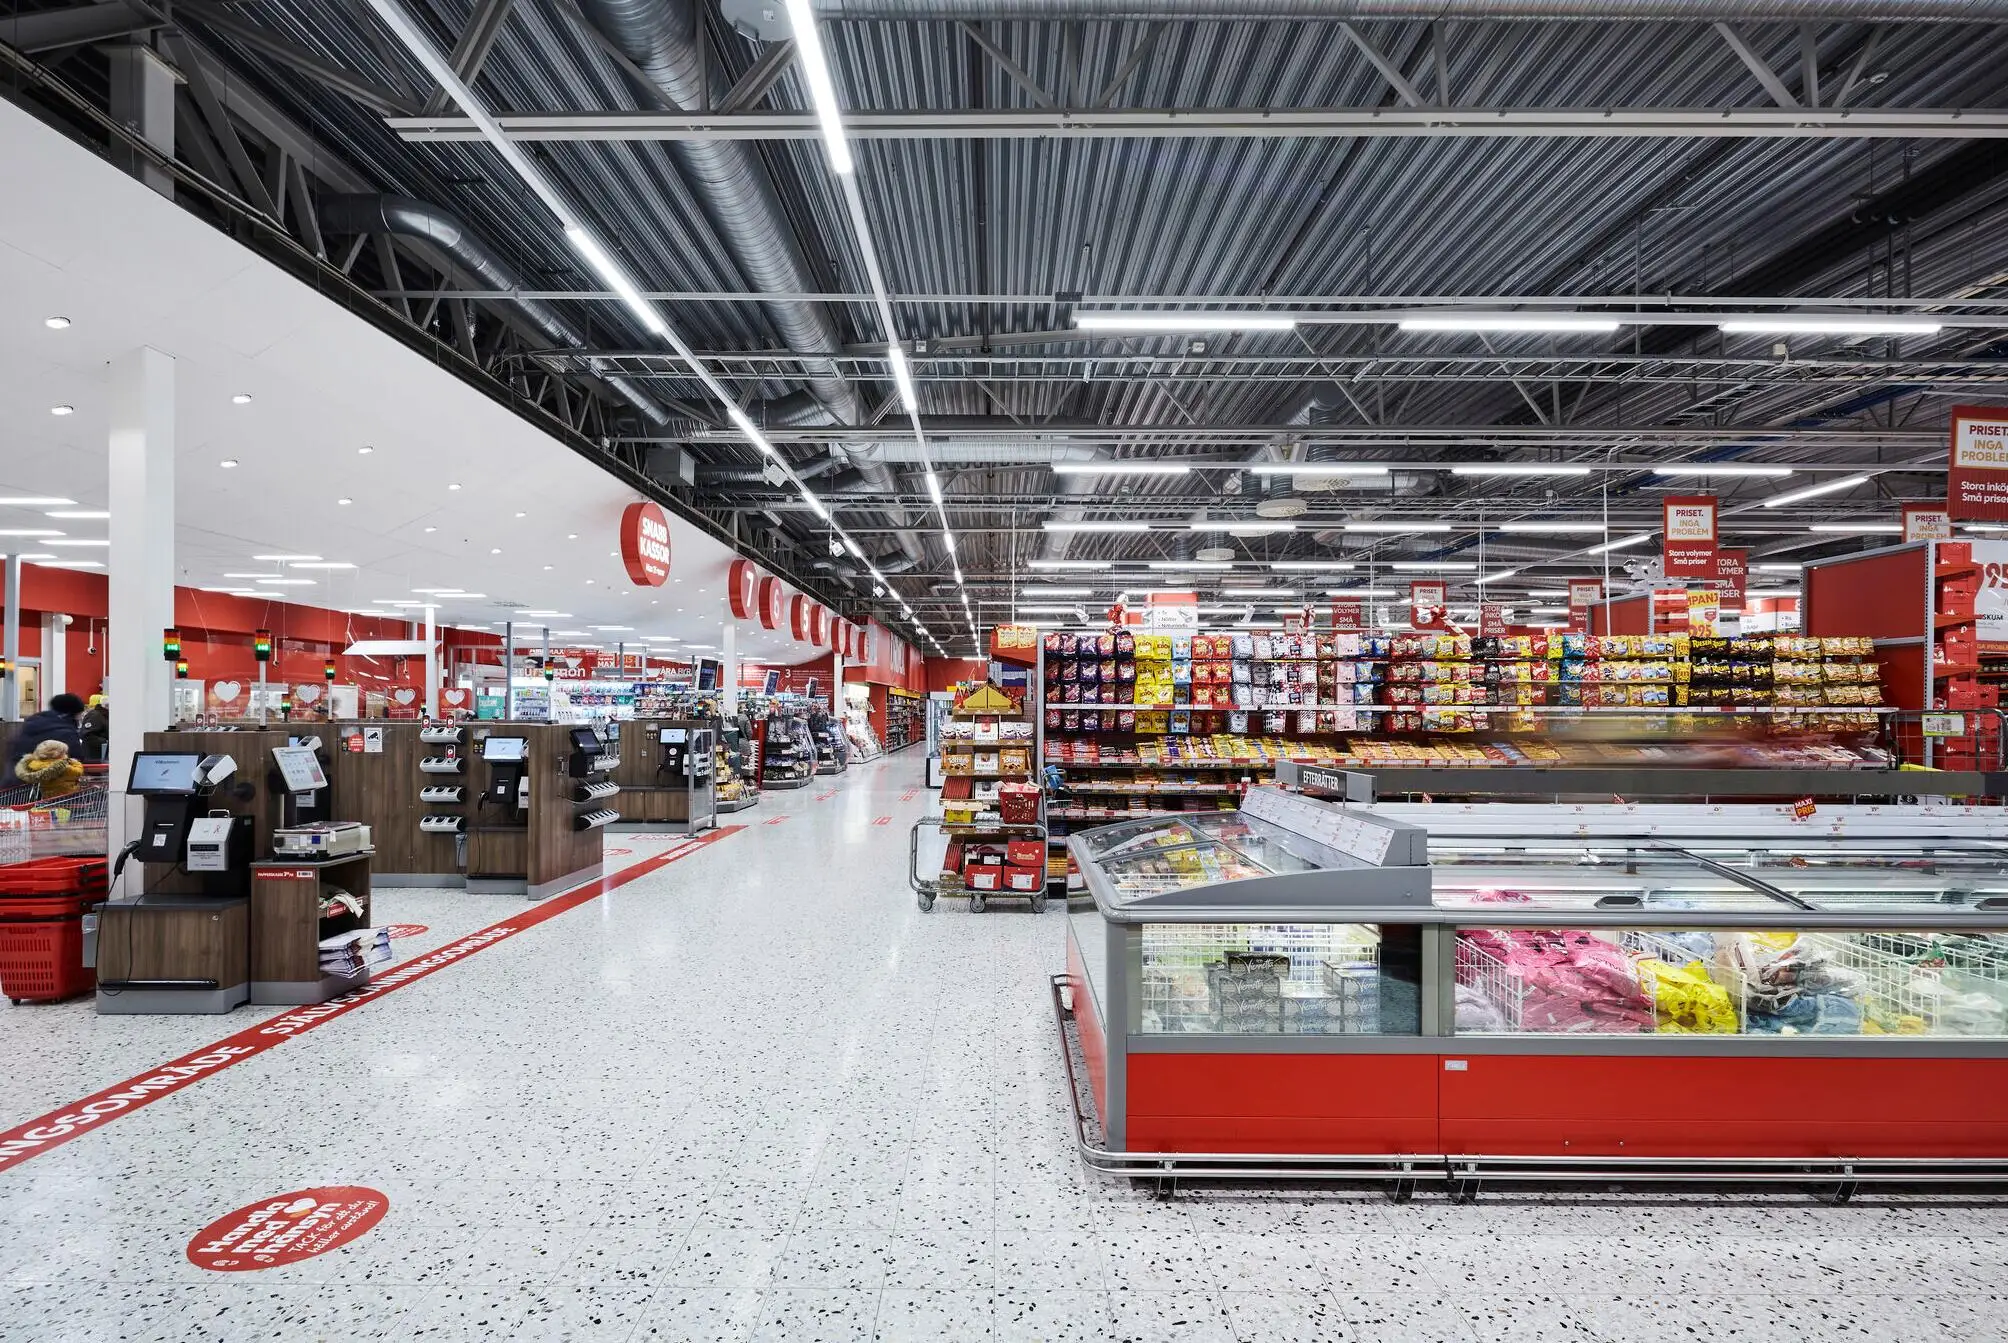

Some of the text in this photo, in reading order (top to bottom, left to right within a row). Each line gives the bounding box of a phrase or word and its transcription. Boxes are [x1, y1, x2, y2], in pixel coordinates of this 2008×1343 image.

[1974, 440, 2003, 450] INGA
[1961, 481, 1985, 491] Stora
[1962, 493, 1983, 502] Små
[1675, 509, 1704, 517] PRISET.
[642, 516, 667, 543] SNABB
[1671, 528, 1709, 536] PROBLEM
[640, 536, 670, 564] KASSOR
[1668, 549, 1713, 559] Stora volymer
[746, 571, 754, 608] 7
[773, 589, 780, 618] 6
[803, 602, 809, 633] 5
[1487, 619, 1502, 627] SMÅ
[785, 669, 791, 678] 3
[1303, 770, 1339, 791] EFTERRÄTTER
[1795, 798, 1812, 808] MAXI
[1797, 805, 1815, 815] PRIS
[197, 1202, 290, 1253] Handla
[253, 1202, 342, 1254] hänsyn
[231, 1220, 290, 1253] med
